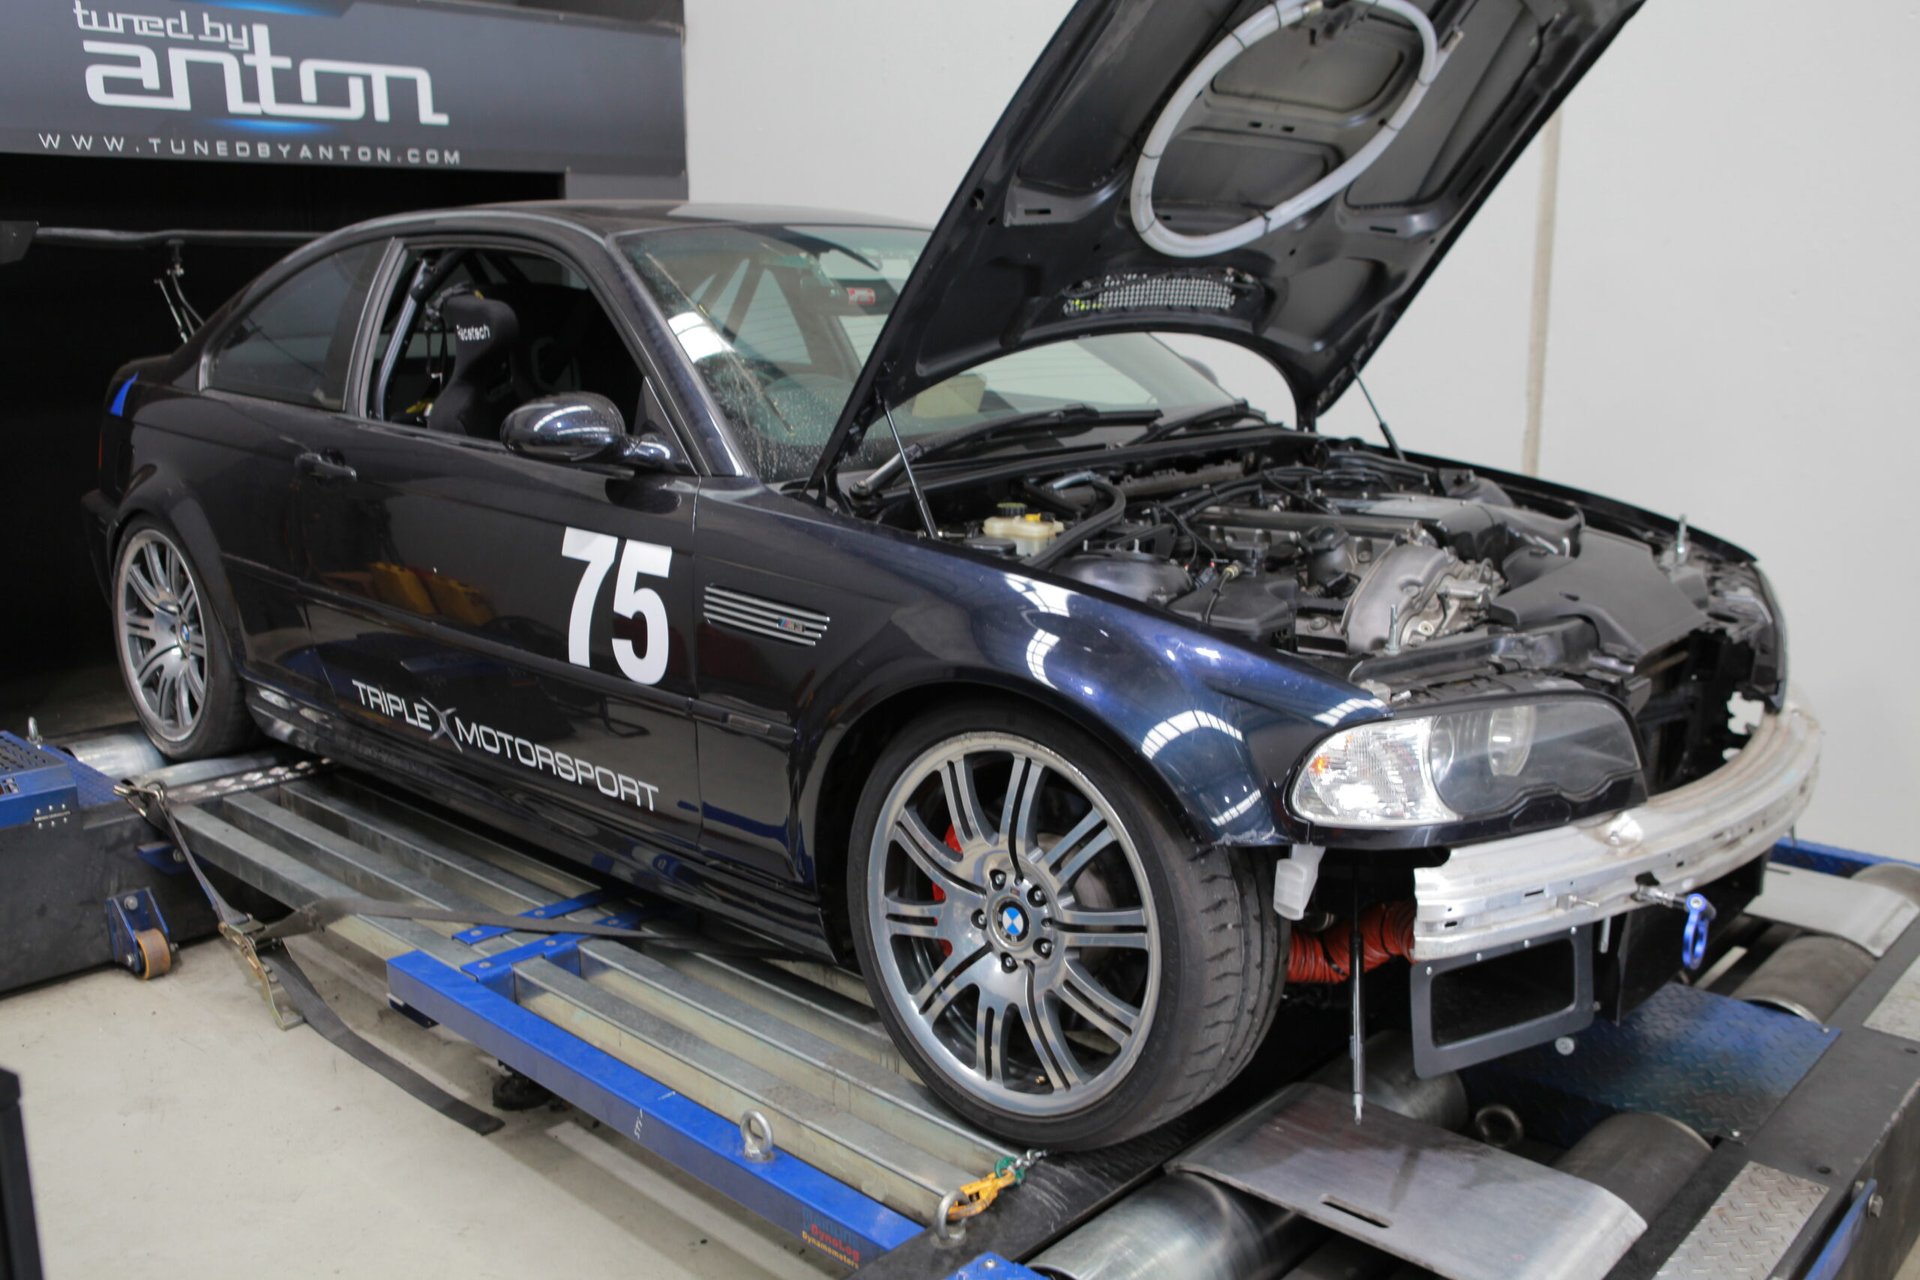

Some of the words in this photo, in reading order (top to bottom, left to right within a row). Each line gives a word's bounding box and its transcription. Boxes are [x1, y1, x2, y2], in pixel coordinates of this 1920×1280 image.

[73, 0, 195, 40] tuned
[199, 12, 250, 50] by
[82, 23, 450, 126] anton
[560, 525, 673, 686] 75
[455, 715, 660, 812] MOTORSPORT
